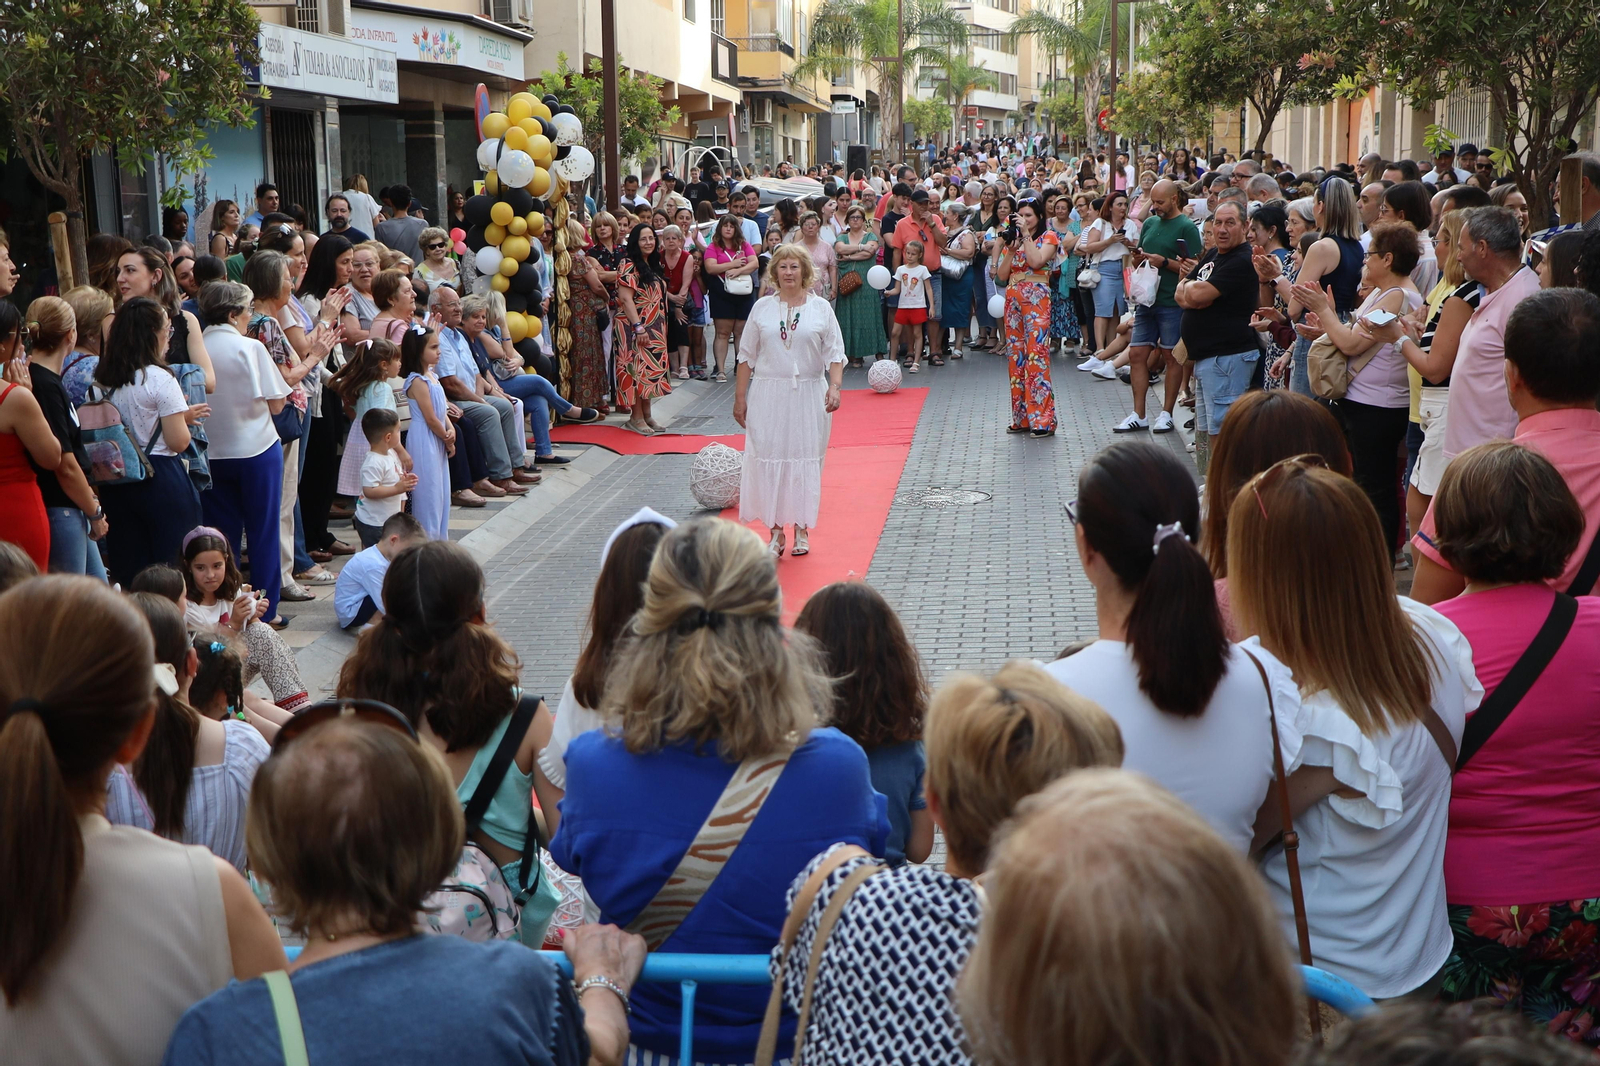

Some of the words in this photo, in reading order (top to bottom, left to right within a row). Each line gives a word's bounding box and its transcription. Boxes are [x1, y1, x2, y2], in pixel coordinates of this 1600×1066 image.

[351, 28, 366, 39] ODA
[326, 53, 331, 77] &
[331, 54, 366, 82] ASOCIADOS
